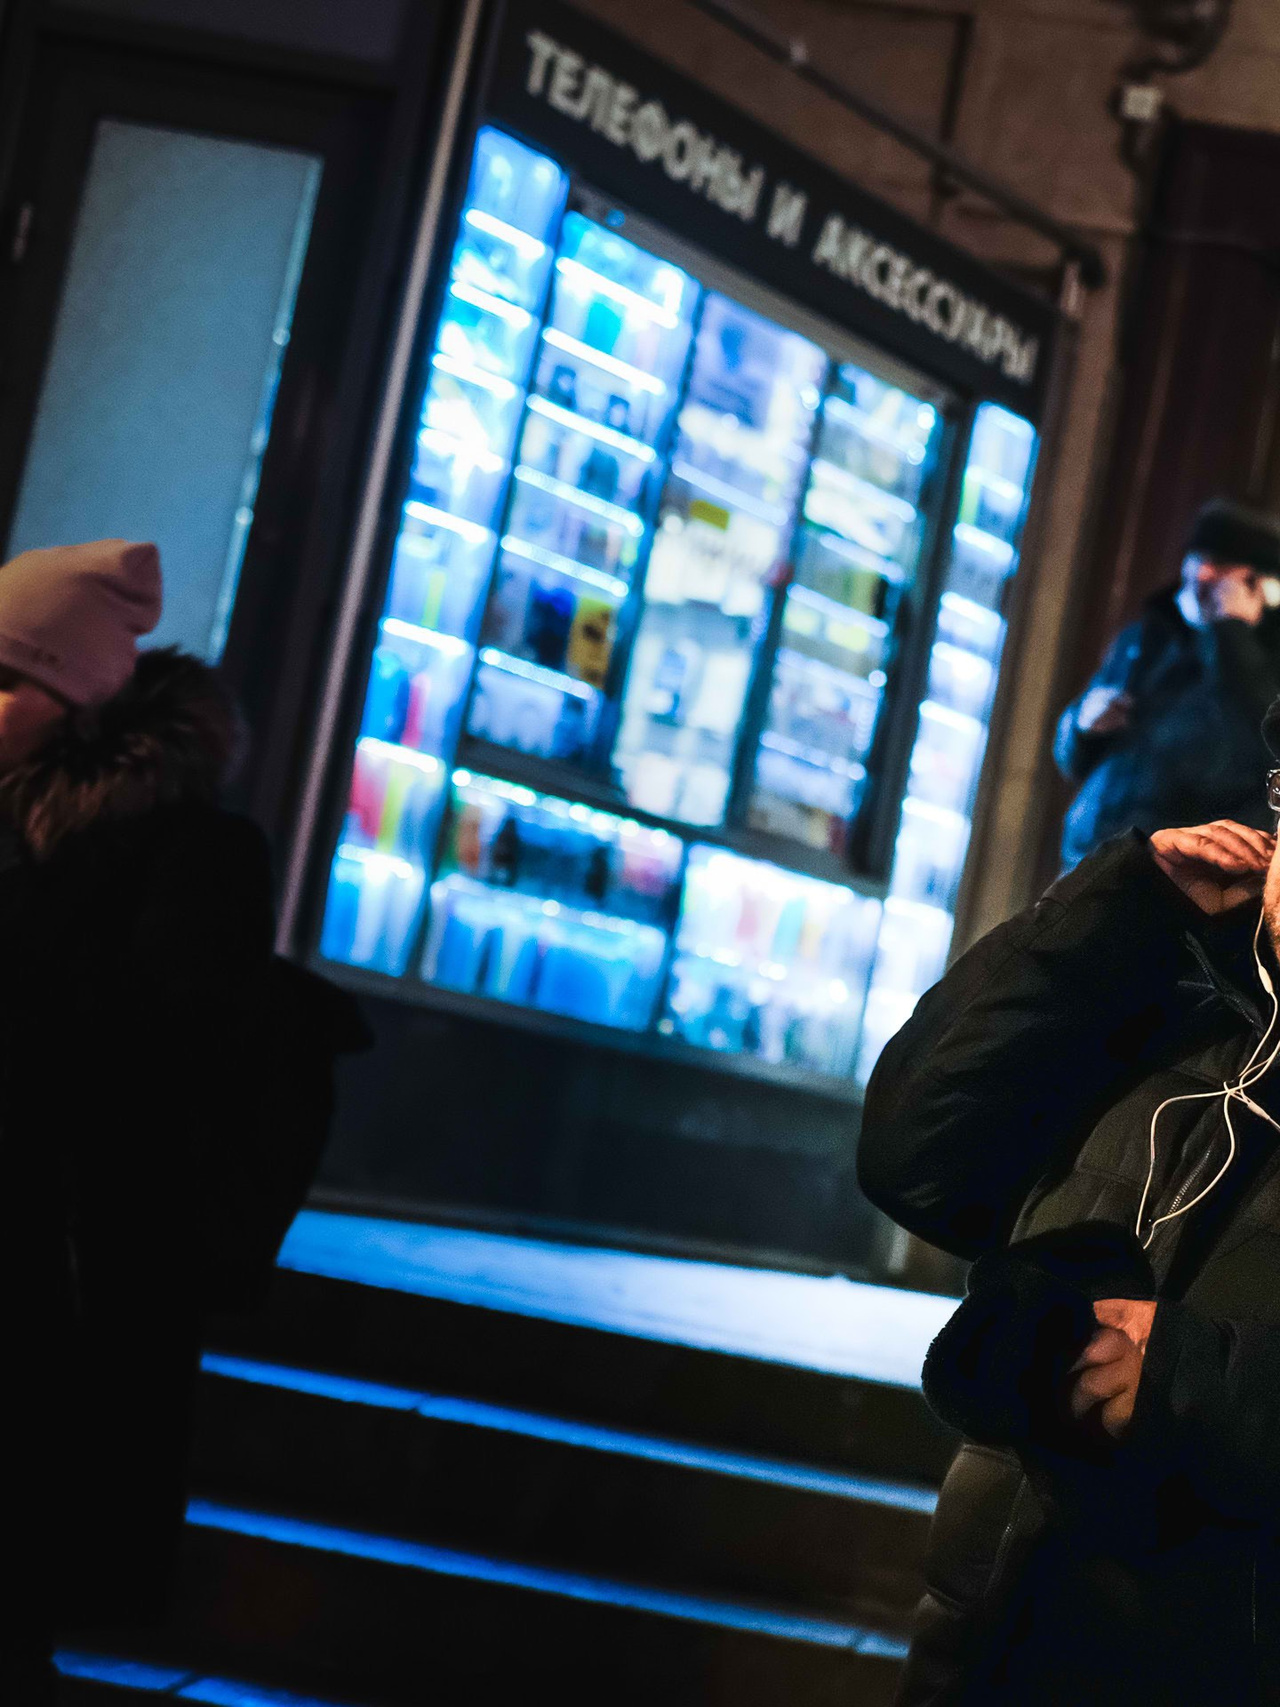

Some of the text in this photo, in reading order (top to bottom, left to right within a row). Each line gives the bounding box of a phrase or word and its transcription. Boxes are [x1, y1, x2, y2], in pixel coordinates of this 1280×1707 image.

[527, 29, 1039, 384] ТЕЛЕФОНЫ И АКСЕССУАРЫ
